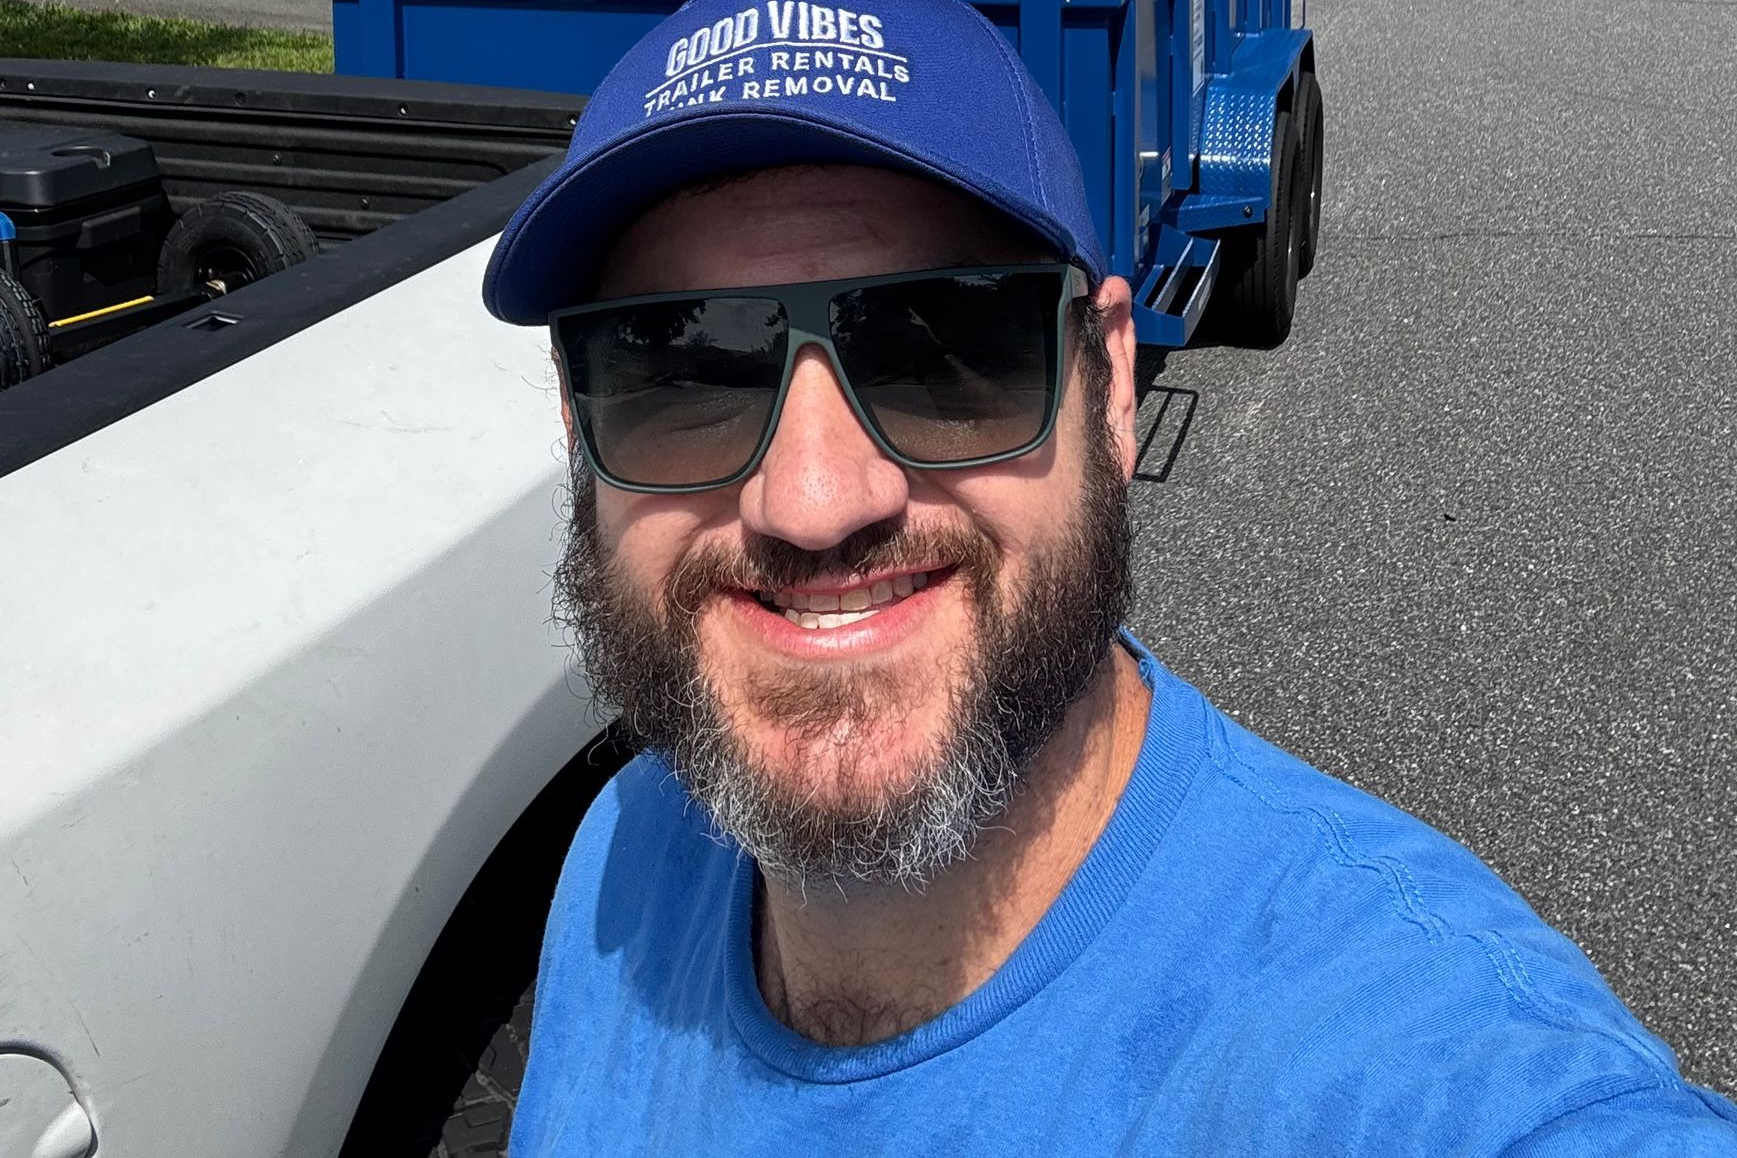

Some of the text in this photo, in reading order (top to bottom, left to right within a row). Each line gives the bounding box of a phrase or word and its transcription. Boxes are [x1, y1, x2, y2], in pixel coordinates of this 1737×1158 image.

[665, 0, 885, 77] GOOD VIBES
[644, 51, 911, 117] TRAILER RENTALS
[743, 74, 897, 102] REMOVAL
